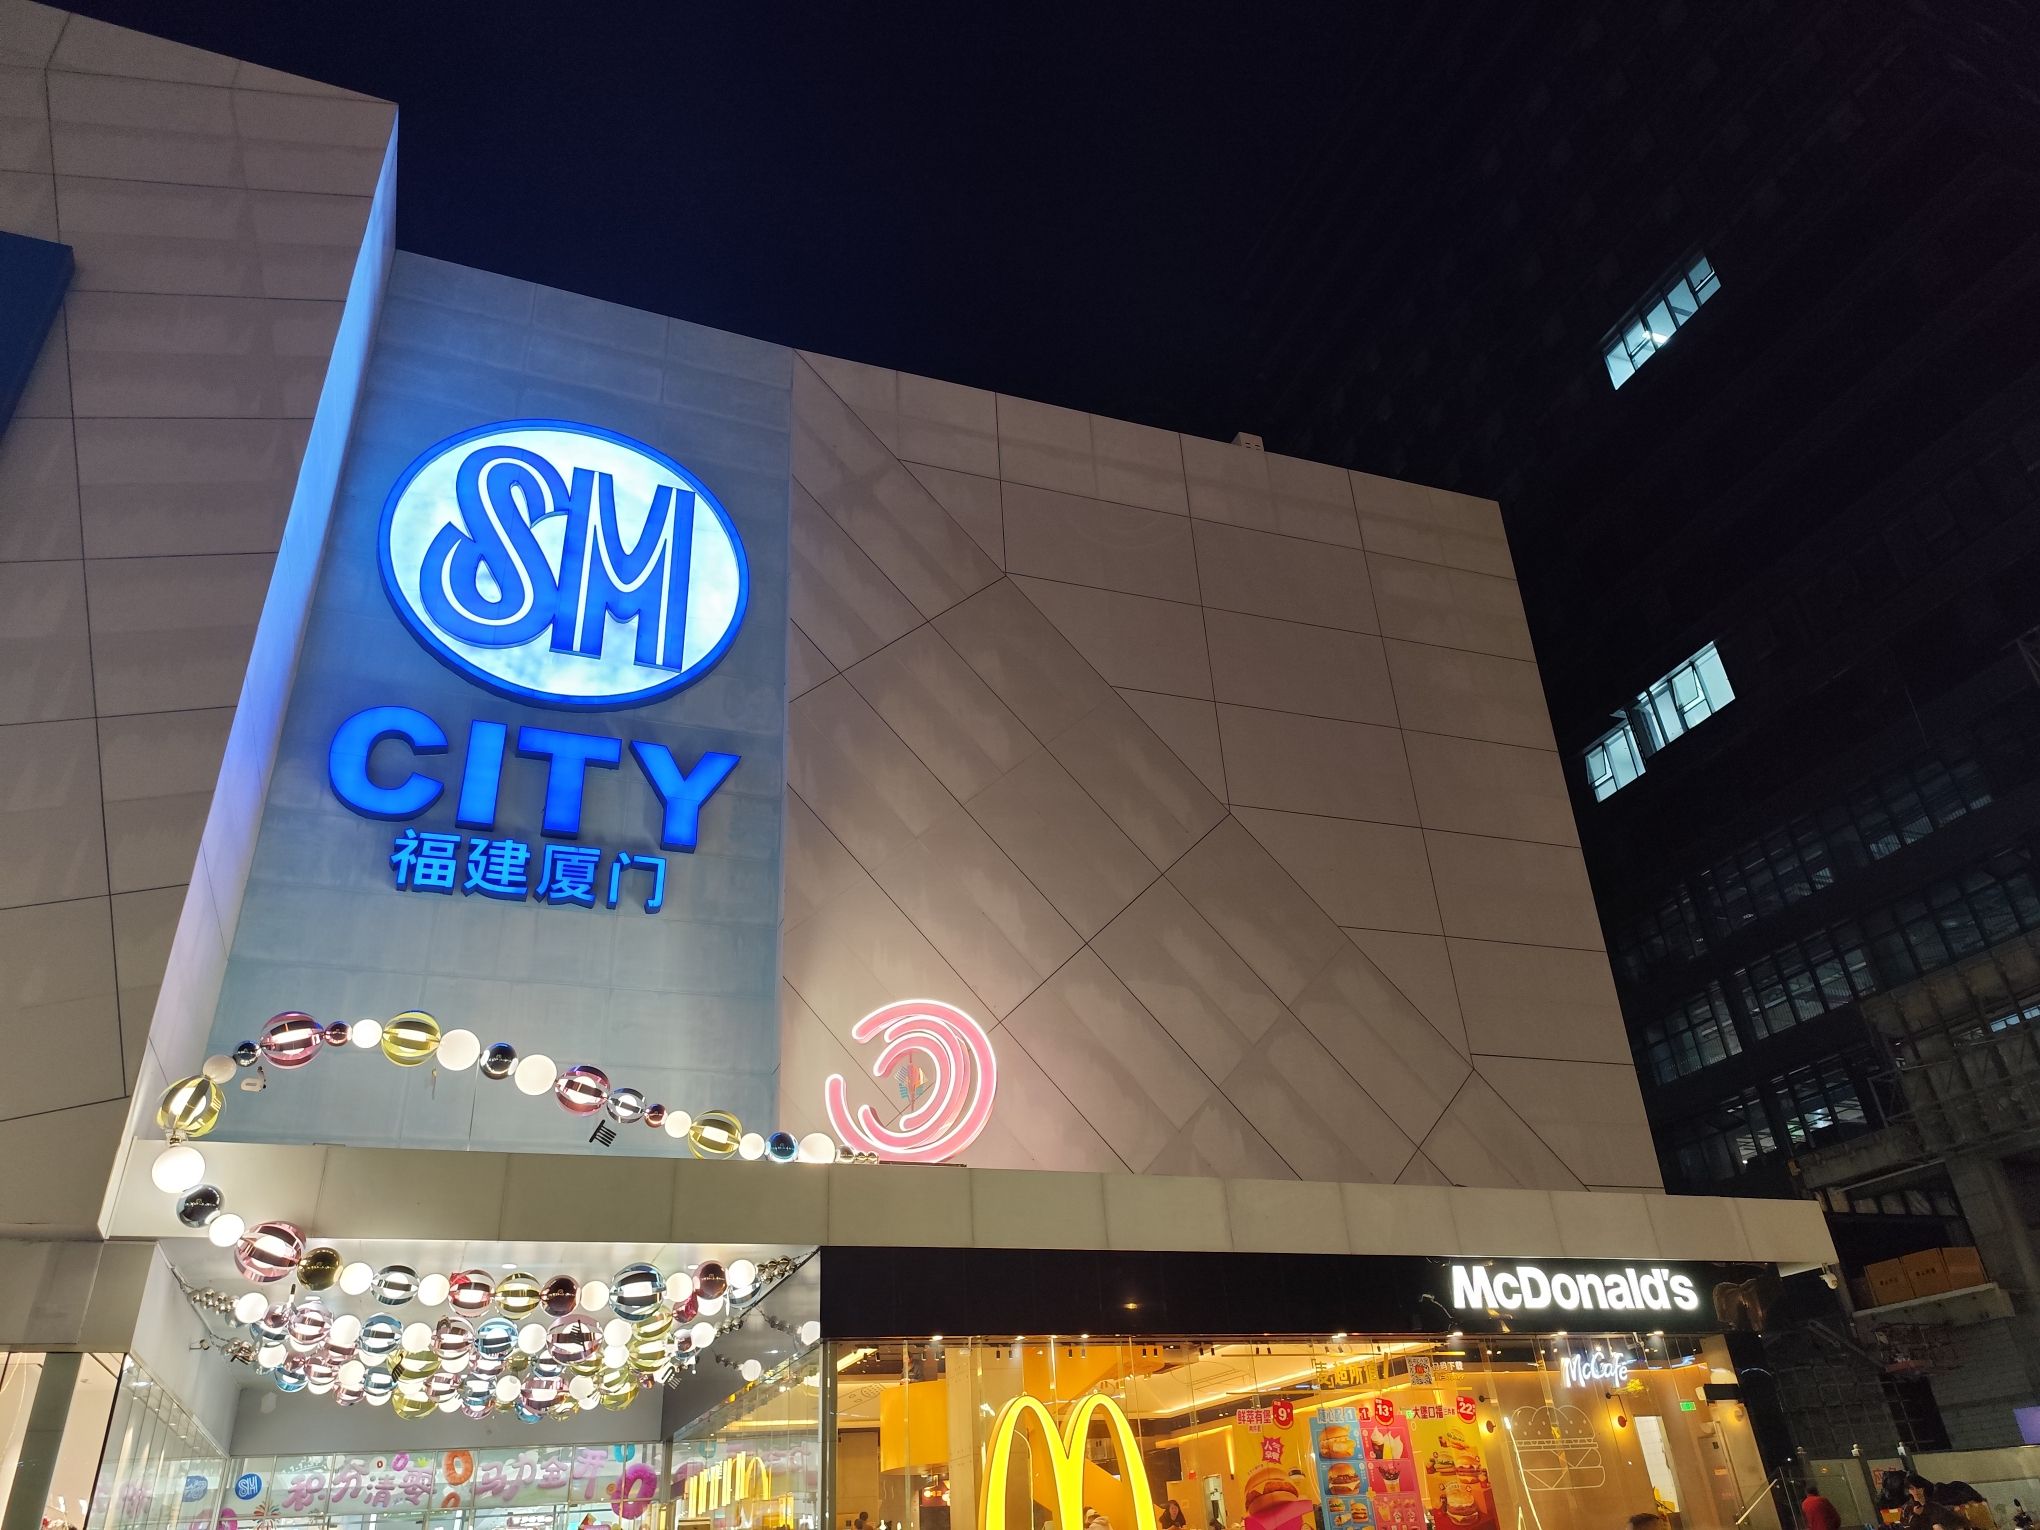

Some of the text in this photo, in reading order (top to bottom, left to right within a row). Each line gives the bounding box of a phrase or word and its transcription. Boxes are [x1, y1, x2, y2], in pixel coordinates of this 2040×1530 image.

[419, 445, 696, 672] SM
[328, 706, 741, 854] CITY
[390, 828, 667, 914] 福建厦门
[1451, 1264, 1699, 1311] McDonald's
